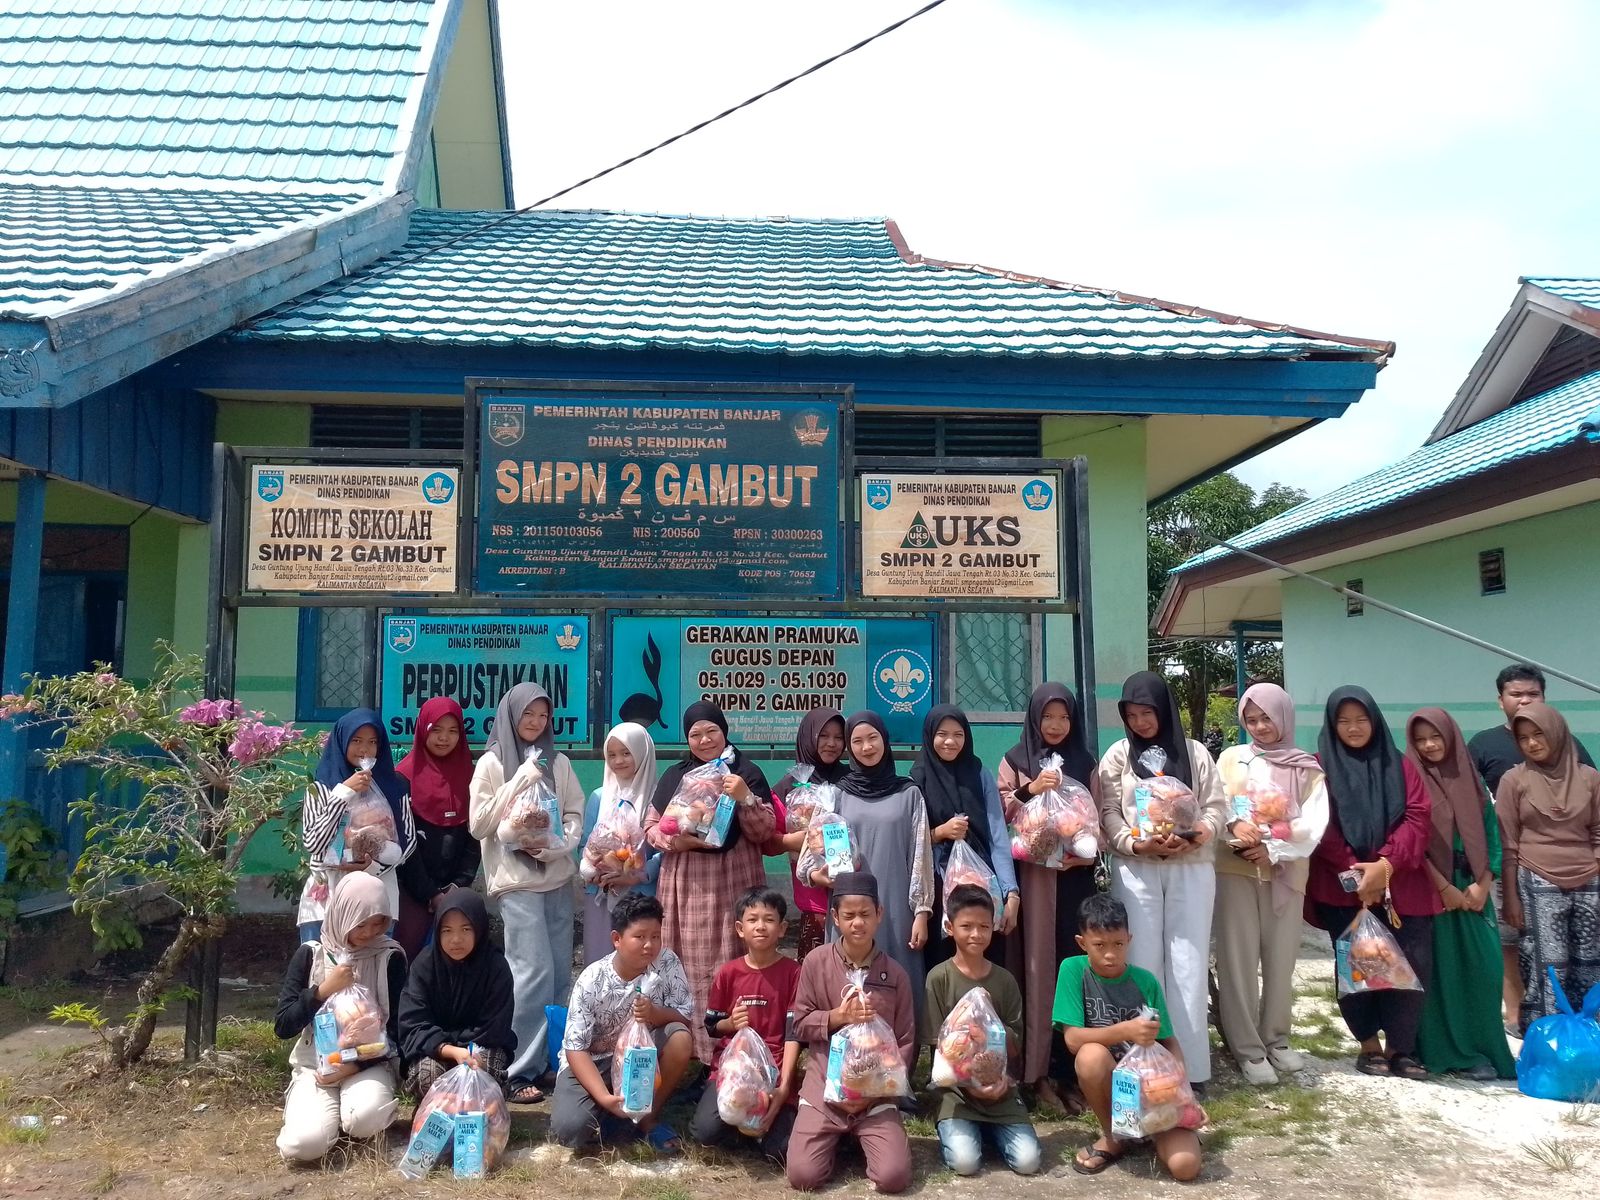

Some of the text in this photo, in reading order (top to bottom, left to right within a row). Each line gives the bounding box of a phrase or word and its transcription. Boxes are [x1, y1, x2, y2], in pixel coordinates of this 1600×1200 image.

[534, 406, 781, 421] PEMERINTAH KABUPATEN BANJAR
[588, 436, 727, 449] DINAS PENDIDIKAN
[290, 474, 419, 487] PEMERINTAH KABUPATEN BANJAR
[495, 459, 818, 508] SMPN 2 GAMBUT
[318, 488, 390, 500] DINAS PENDIDIKAN
[897, 483, 1016, 495] PEMERINTAH KABUPATEN BANJAR
[924, 496, 990, 506] DINAS PENDIDIKAN
[270, 508, 432, 540] KOMITE SEKOLAH
[492, 525, 513, 536] NSS
[523, 526, 602, 536] 201150103056
[632, 527, 650, 538] NIS
[660, 528, 700, 538] 200560
[733, 528, 762, 539] NPSN
[771, 529, 823, 540] 30300263
[932, 515, 1021, 546] UKS
[258, 544, 447, 563] SMPN 2 GAMBUT
[512, 548, 557, 556] Guntung
[560, 548, 589, 556] Ujung
[661, 550, 698, 558] Tengah
[668, 562, 717, 570] SELATAN
[881, 553, 1040, 568] SMPN 2 GAMBUT
[251, 563, 266, 571] Desa
[268, 564, 293, 573] Guntung
[295, 564, 312, 574] Ujung
[314, 564, 335, 572] Handil
[354, 565, 376, 574] Tengah
[395, 565, 413, 573] No.33
[428, 566, 452, 575] Gambut
[498, 567, 553, 575] AKREDITASI
[789, 570, 816, 578] 70652
[866, 569, 880, 577] Desa
[881, 570, 906, 578] Guntung
[925, 569, 945, 577] Handil
[963, 570, 983, 578] Tengah
[1002, 570, 1018, 578] No.33
[274, 573, 306, 582] Kabupaten
[308, 573, 329, 582] Banjar
[351, 574, 429, 583] smpngambut2gmail.com
[888, 578, 919, 587] Kabupaten
[920, 578, 940, 587] Banjar
[317, 581, 387, 590] KALIMANTAN SELATAN
[928, 586, 994, 594] KALIMANTAN SELATAN
[420, 624, 549, 635] PEMERINTAH KABUPATEN BANJAR
[686, 626, 859, 645] GERAKAN PRAMUKA
[448, 638, 520, 649] DINAS PENDIDIKAN
[711, 648, 834, 666] GUGUS DEPAN
[698, 671, 765, 689] 05.1029
[780, 672, 847, 689] 05.1030
[756, 693, 766, 711] 2
[771, 694, 844, 711] GAMBUT
[466, 717, 475, 734] 2
[483, 716, 578, 735] GUT
[1116, 1080, 1136, 1090] ULTRA
[1118, 1087, 1134, 1096] MILK
[428, 1122, 447, 1136] ULTRA
[428, 1128, 443, 1140] MILK
